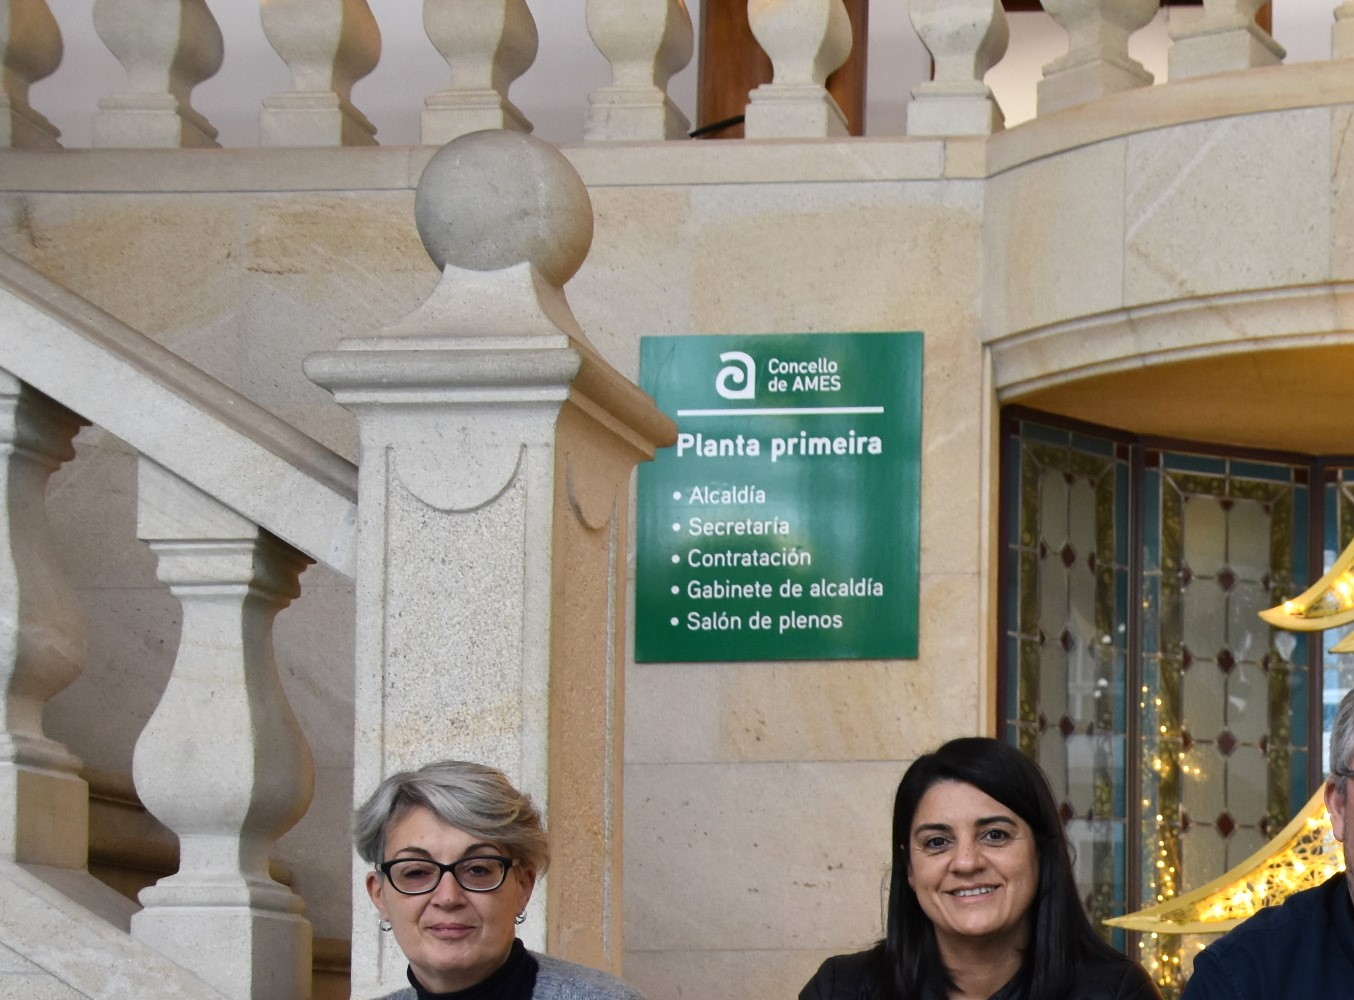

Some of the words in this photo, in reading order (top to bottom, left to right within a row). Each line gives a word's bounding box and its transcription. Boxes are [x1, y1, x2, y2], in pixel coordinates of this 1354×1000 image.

[768, 357, 838, 375] Concello
[768, 375, 788, 392] de
[792, 375, 841, 392] AMES
[677, 432, 760, 457] Planta
[771, 429, 882, 462] primeira
[689, 485, 766, 505] Alcaldía
[688, 517, 789, 537] Secretaría
[687, 549, 811, 568] Contratación
[687, 580, 772, 599] Gabinete
[779, 579, 801, 598] de
[810, 577, 884, 598] alcaldía
[687, 611, 742, 631] Salón
[749, 611, 772, 630] de
[779, 610, 843, 634] plenos
